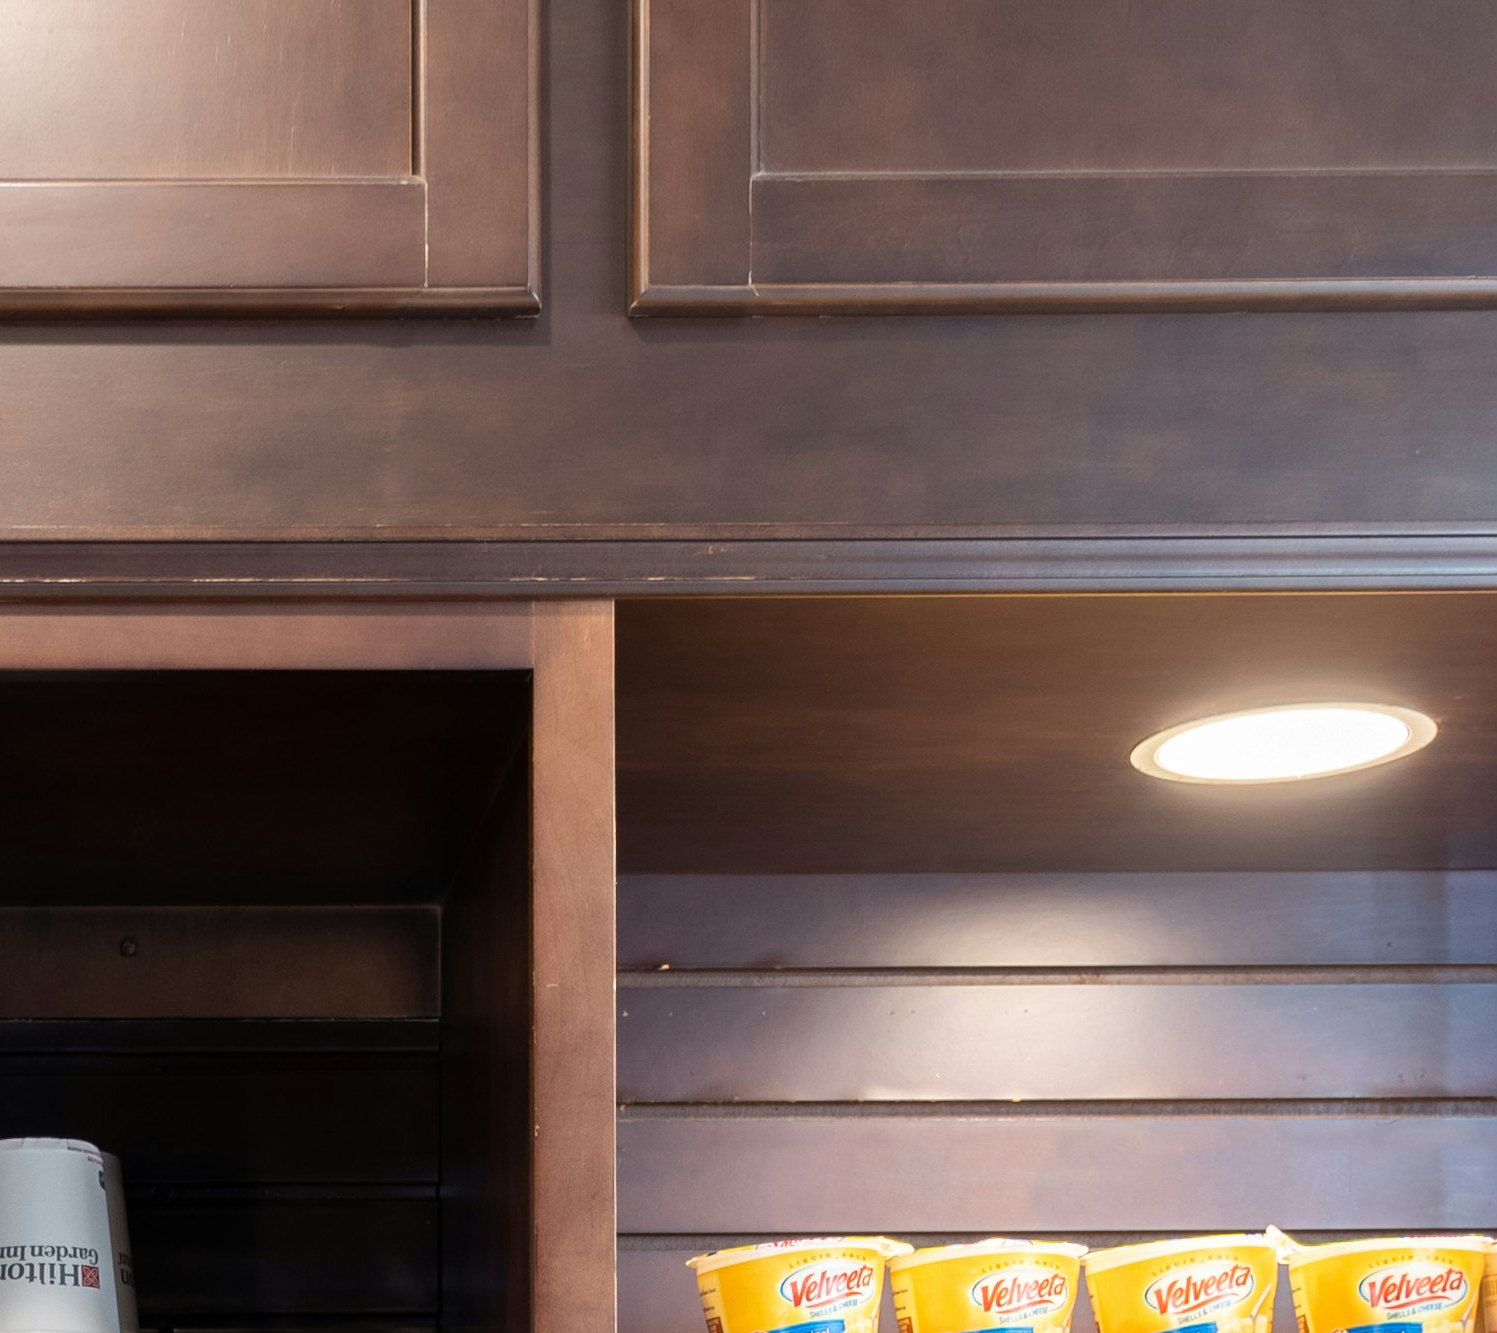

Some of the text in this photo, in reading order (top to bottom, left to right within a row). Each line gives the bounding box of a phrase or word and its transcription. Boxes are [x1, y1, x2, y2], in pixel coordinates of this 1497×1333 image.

[30, 1246, 99, 1264] Garden
[790, 1265, 875, 1308] Velveeta
[980, 1274, 1066, 1313] Velveeta
[1154, 1264, 1252, 1314] Velveeta
[1368, 1271, 1463, 1309] Velveeta
